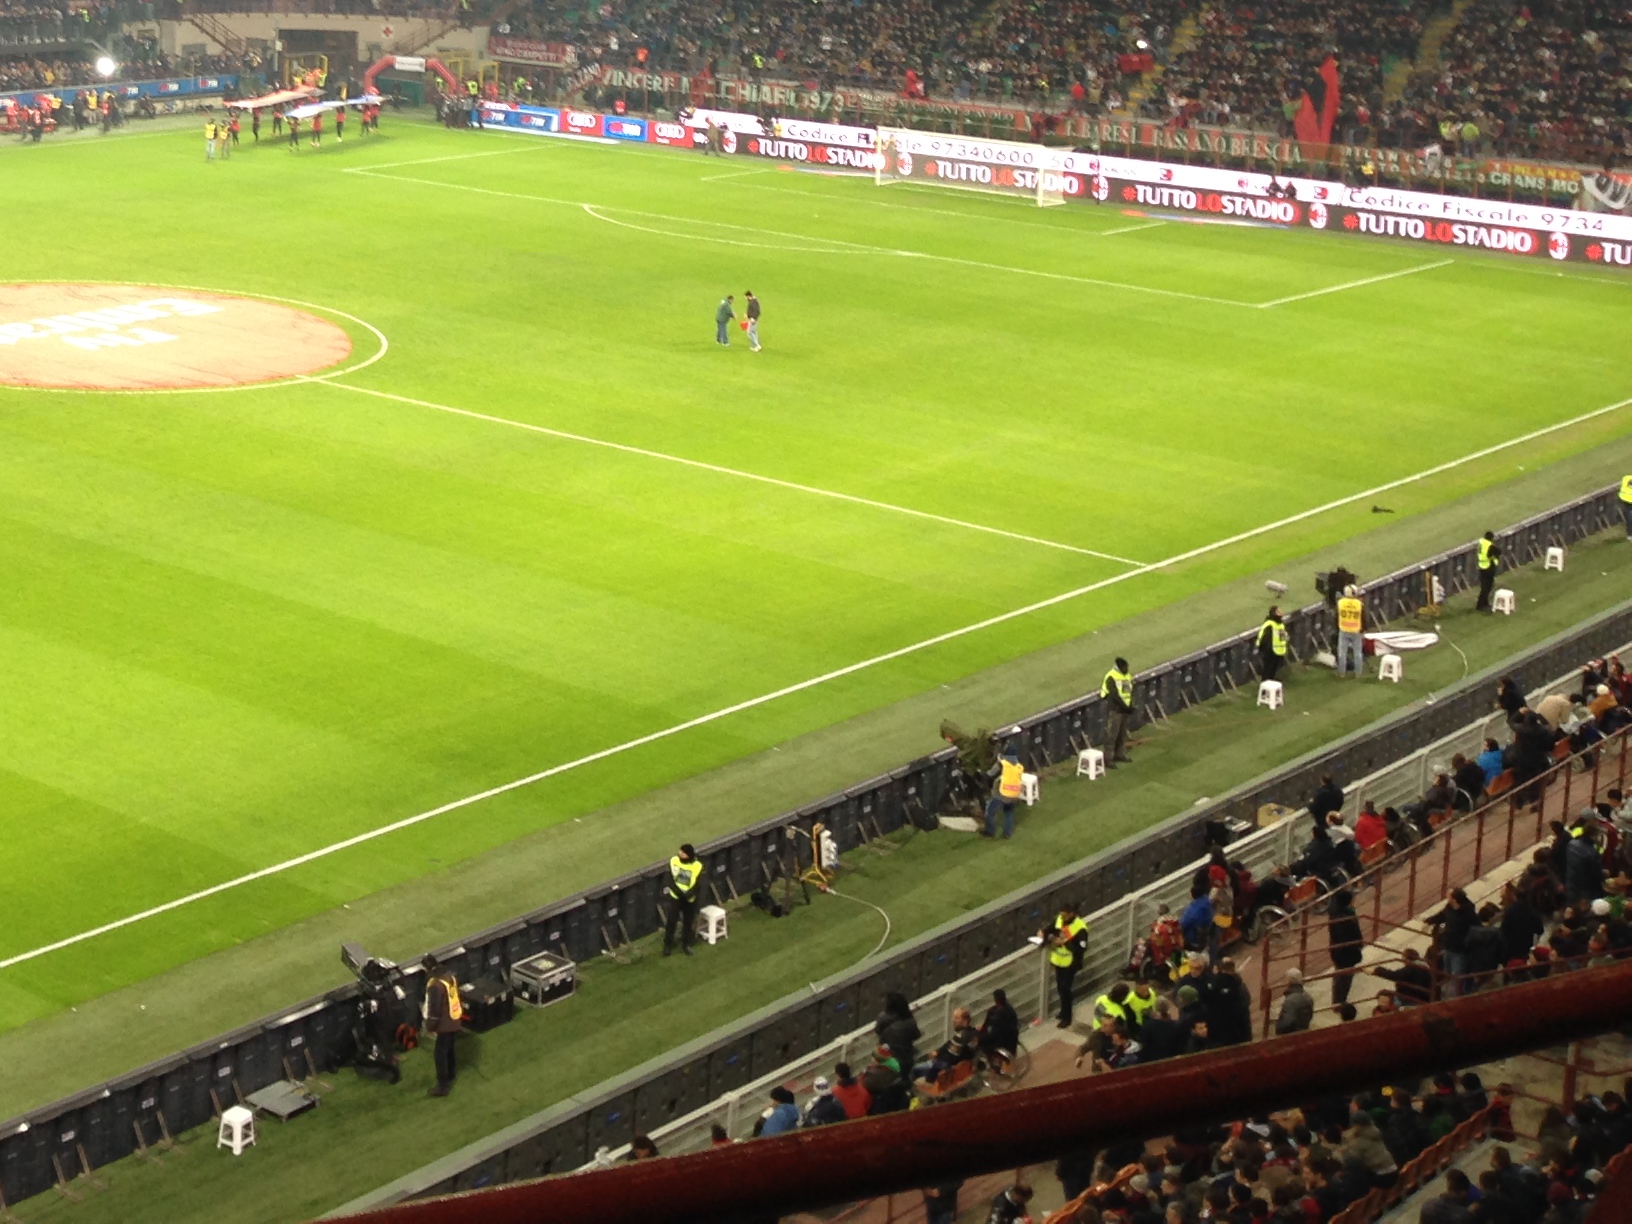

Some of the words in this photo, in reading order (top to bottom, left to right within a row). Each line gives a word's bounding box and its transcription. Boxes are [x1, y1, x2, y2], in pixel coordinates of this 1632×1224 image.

[788, 124, 848, 143] Codice
[1348, 188, 1430, 211] Codice
[1442, 201, 1528, 222] Fiscale
[1541, 213, 1605, 231] 9734
